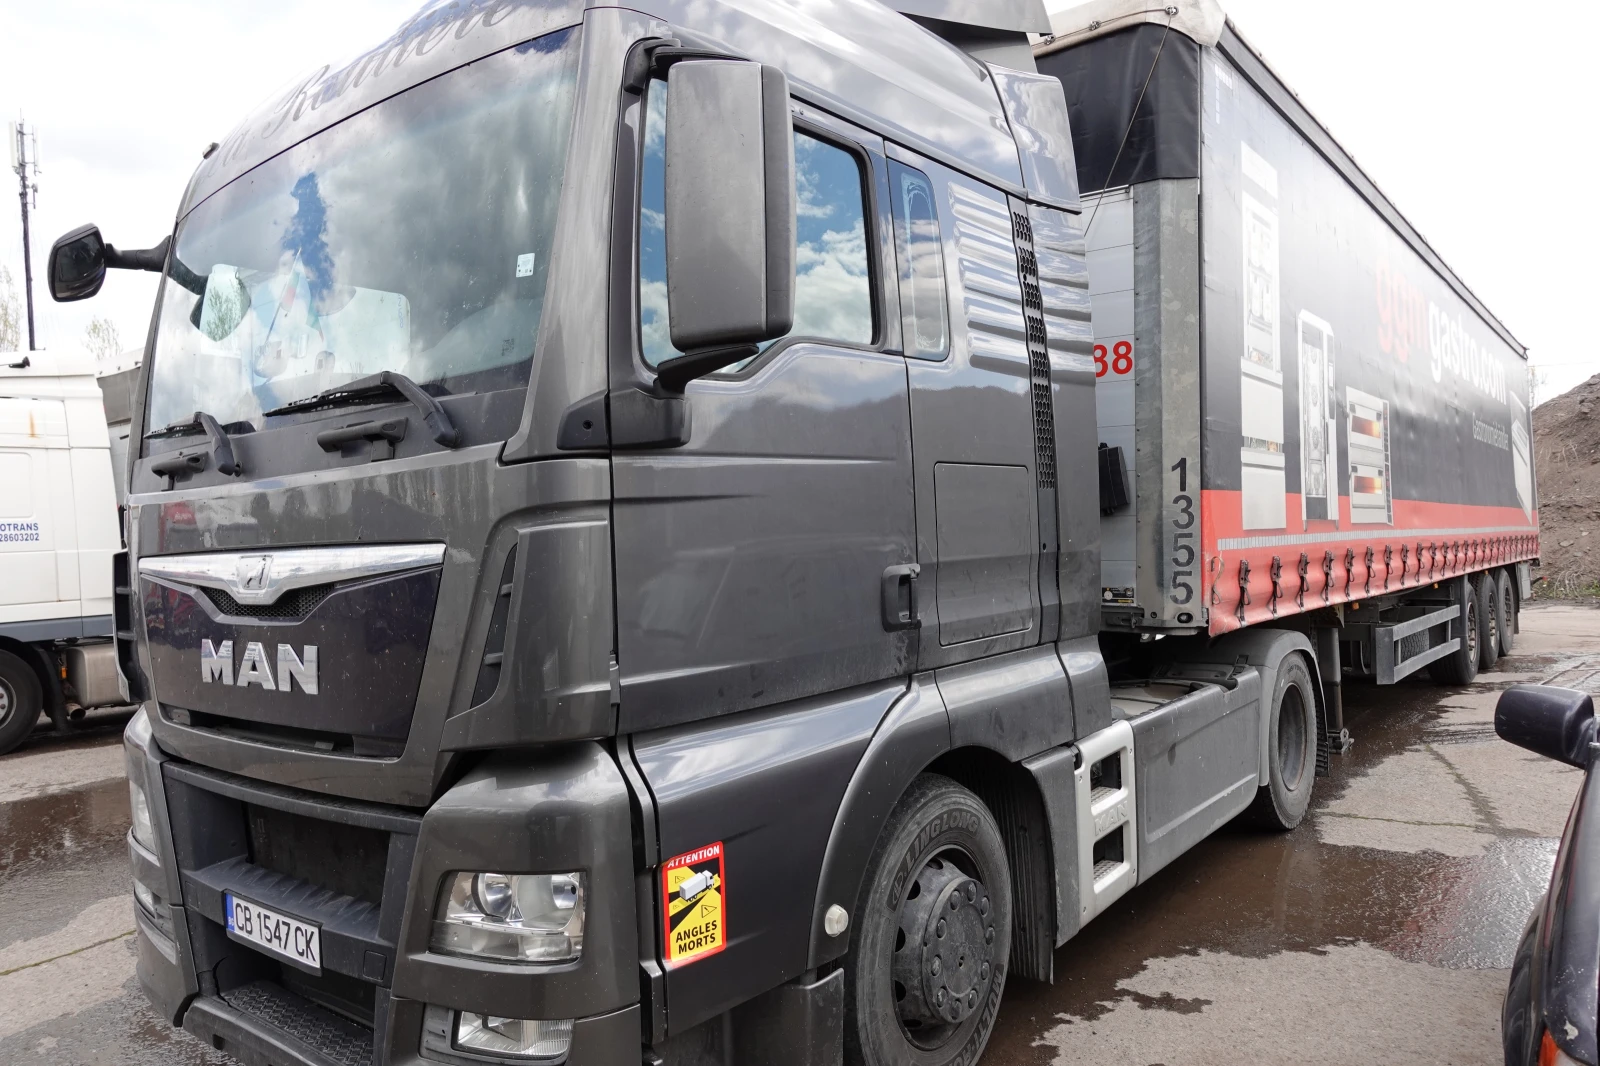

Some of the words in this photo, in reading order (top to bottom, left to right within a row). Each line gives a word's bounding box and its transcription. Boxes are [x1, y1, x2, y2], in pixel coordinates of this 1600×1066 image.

[1170, 457, 1195, 605] 1355
[201, 638, 319, 695] MAN
[906, 811, 979, 872] LINGLONG
[1094, 800, 1128, 837] MAN
[667, 844, 721, 869] ATTENTION
[235, 902, 253, 934] CB
[257, 911, 290, 950] 1547
[294, 925, 316, 962] CK
[675, 919, 718, 944] ANGLES
[678, 932, 717, 955] MORTS
